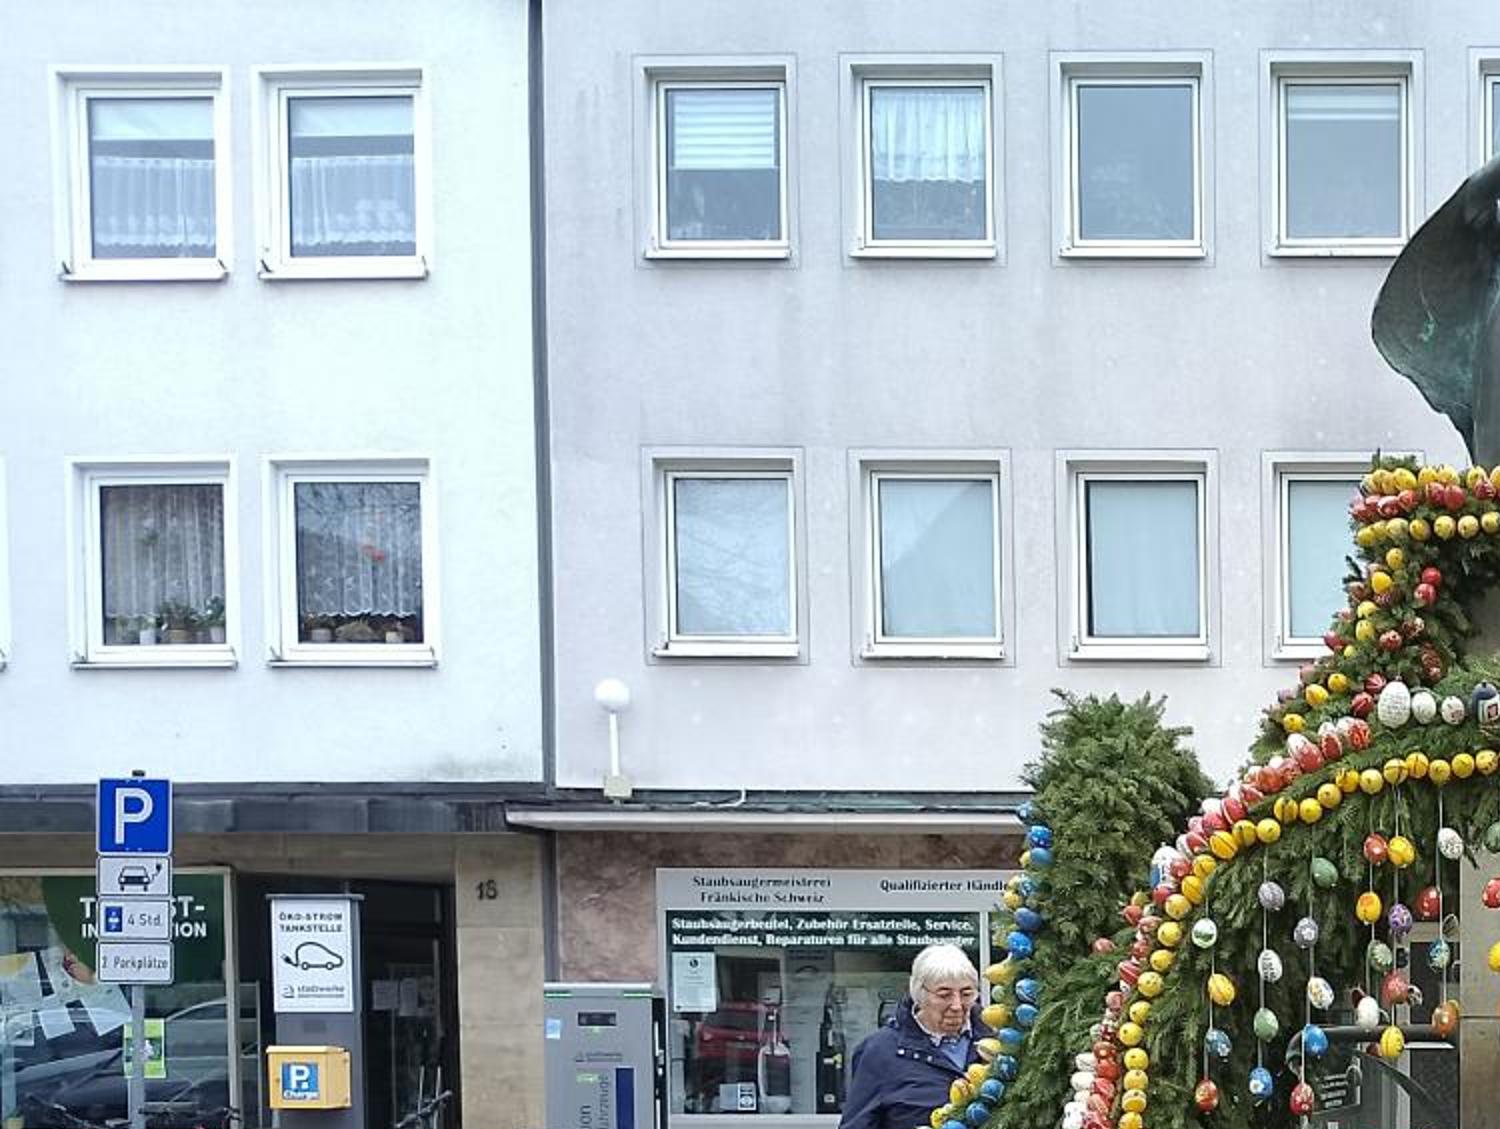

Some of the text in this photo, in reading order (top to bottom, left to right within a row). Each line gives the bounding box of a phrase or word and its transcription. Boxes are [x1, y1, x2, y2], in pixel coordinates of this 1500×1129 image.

[114, 787, 153, 845] P
[693, 876, 831, 889] Staubsaugermeisterei
[880, 879, 962, 892] Qualifizierter
[701, 891, 825, 902] Fränkische Schweiz
[127, 914, 135, 926] 4
[672, 917, 793, 931] Staubsaugerbeutel,
[797, 918, 849, 930] Zubehör
[279, 924, 342, 932] TANKSTELLE
[672, 933, 763, 946] Kundendienst,
[766, 934, 844, 946] Reparaturen
[848, 933, 867, 945] für
[869, 934, 893, 945] alle
[113, 955, 168, 970] Parkplätze
